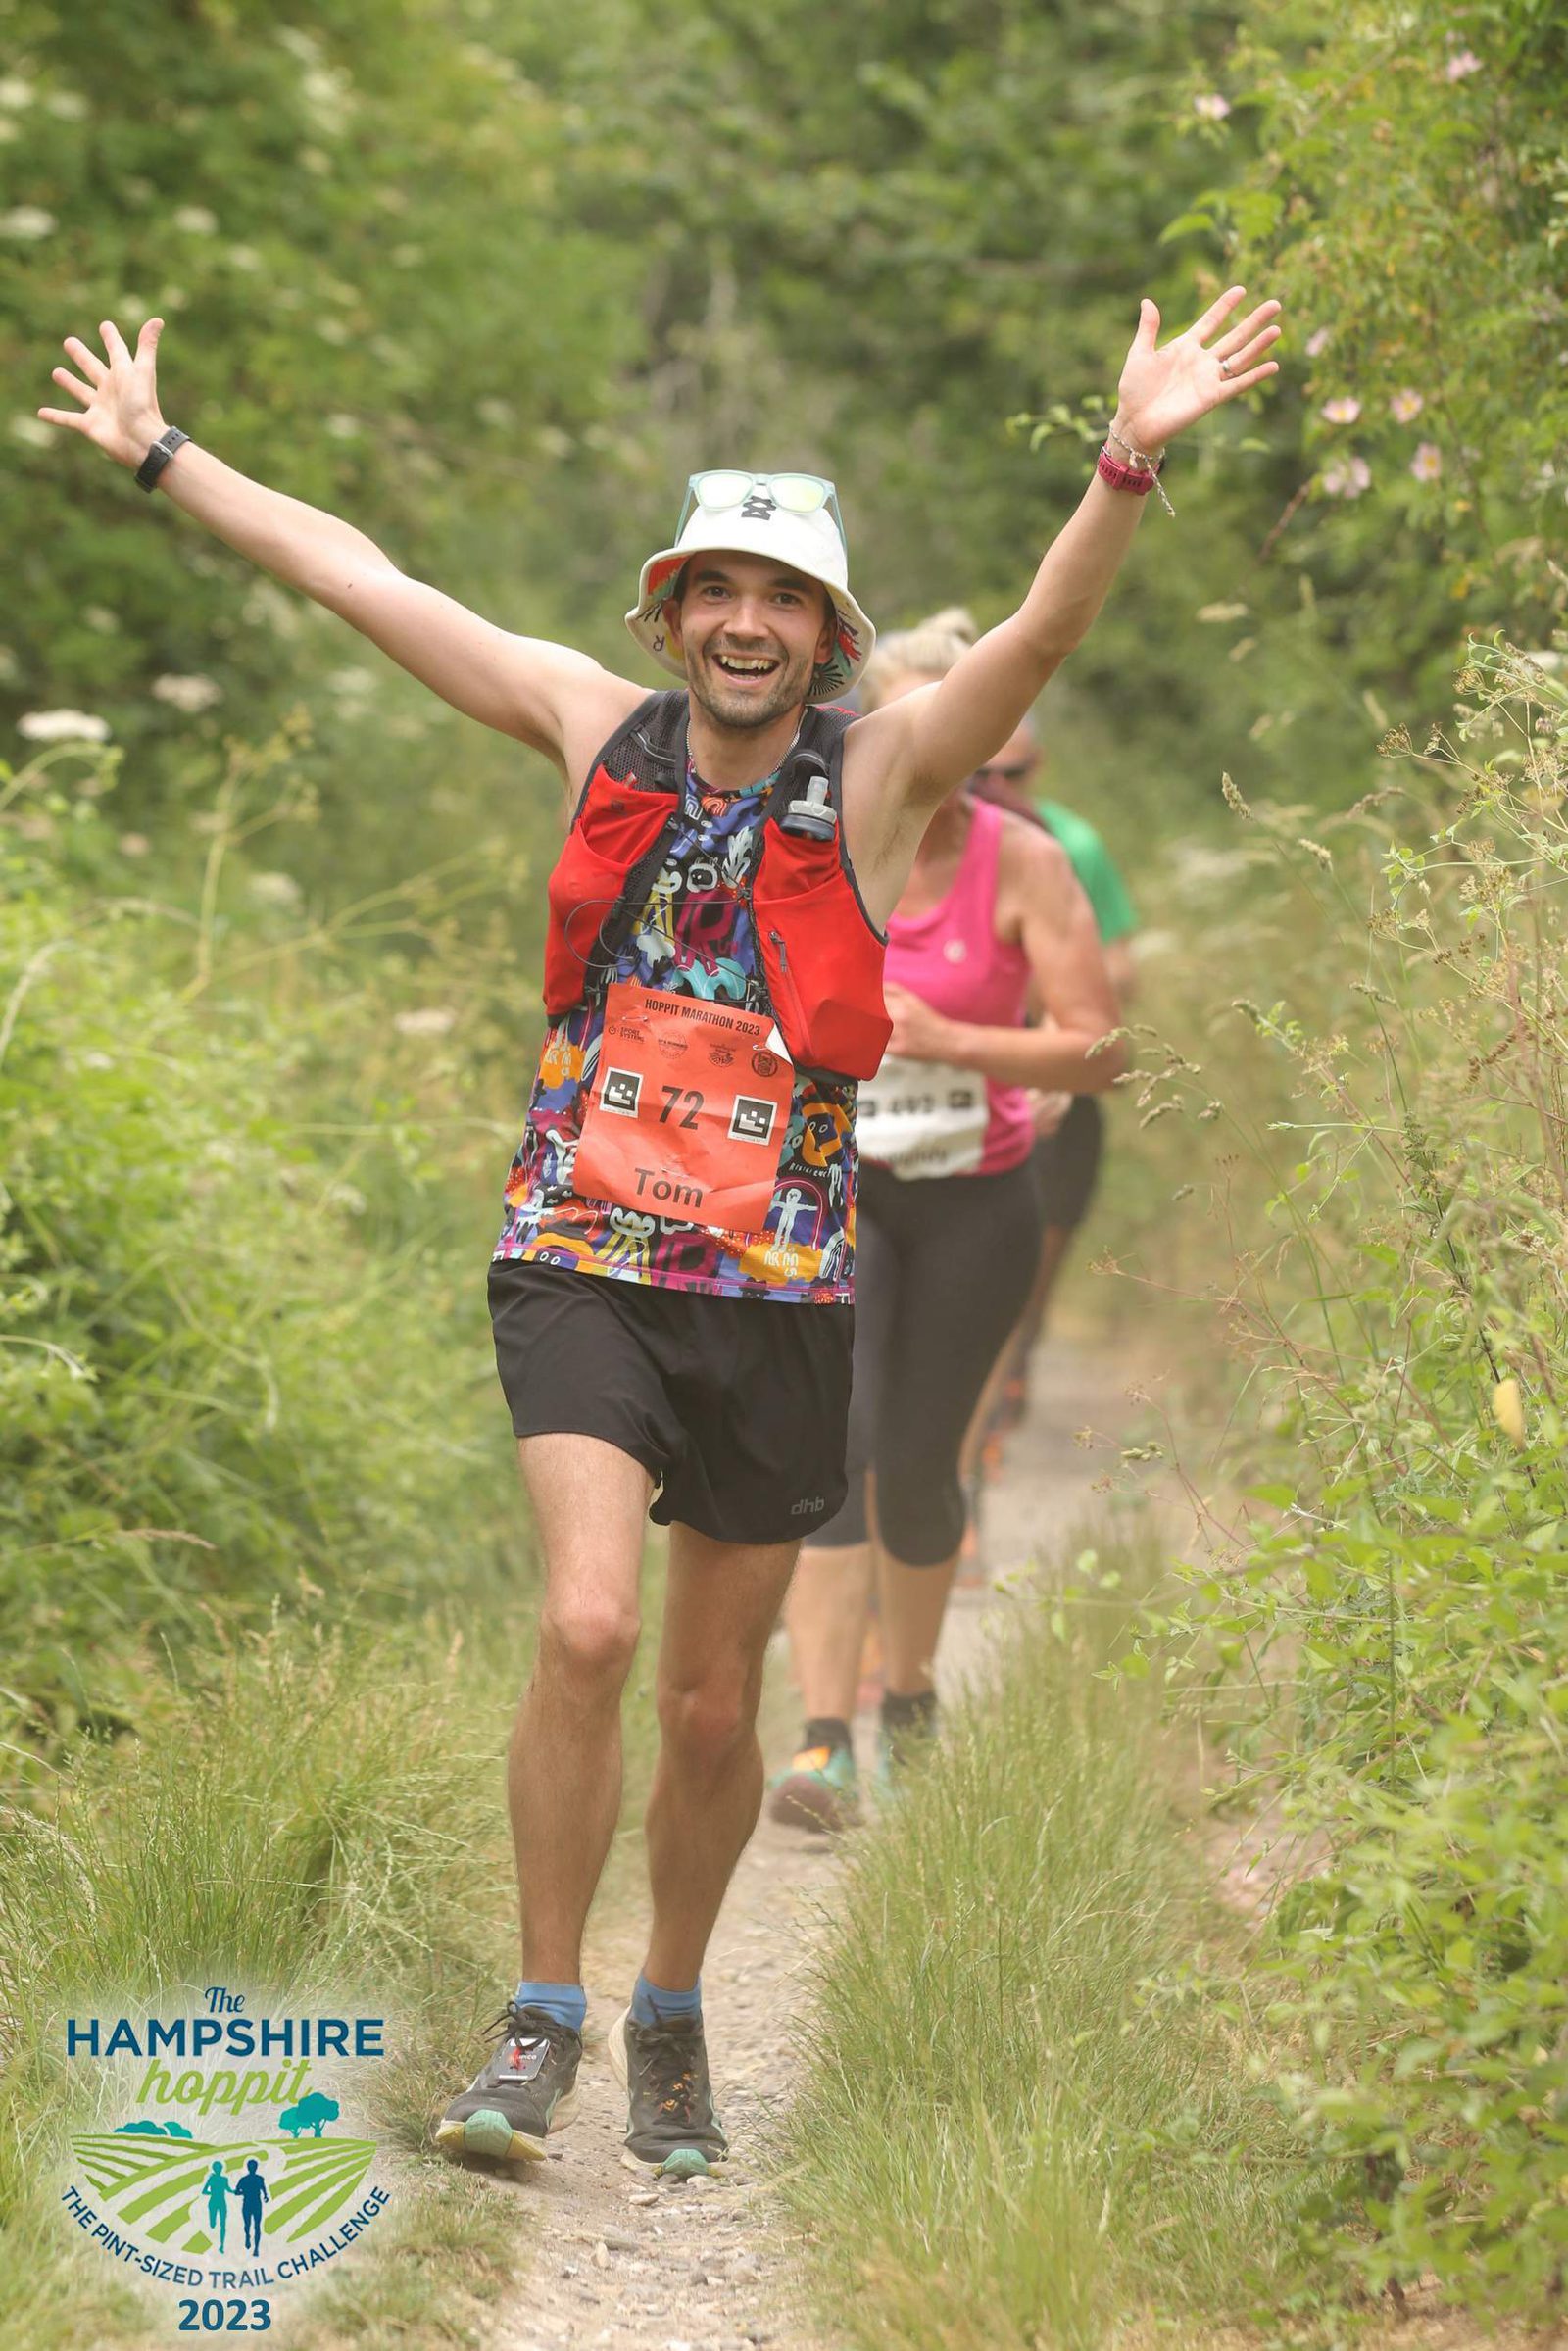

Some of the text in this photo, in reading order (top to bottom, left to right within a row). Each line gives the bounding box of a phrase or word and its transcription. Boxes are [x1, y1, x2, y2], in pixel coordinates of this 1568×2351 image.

[645, 999, 760, 1036] HOPPIT MARATHON 2023
[659, 1085, 705, 1130] 72
[634, 1167, 704, 1208] Tom
[790, 1496, 825, 1515] dhb
